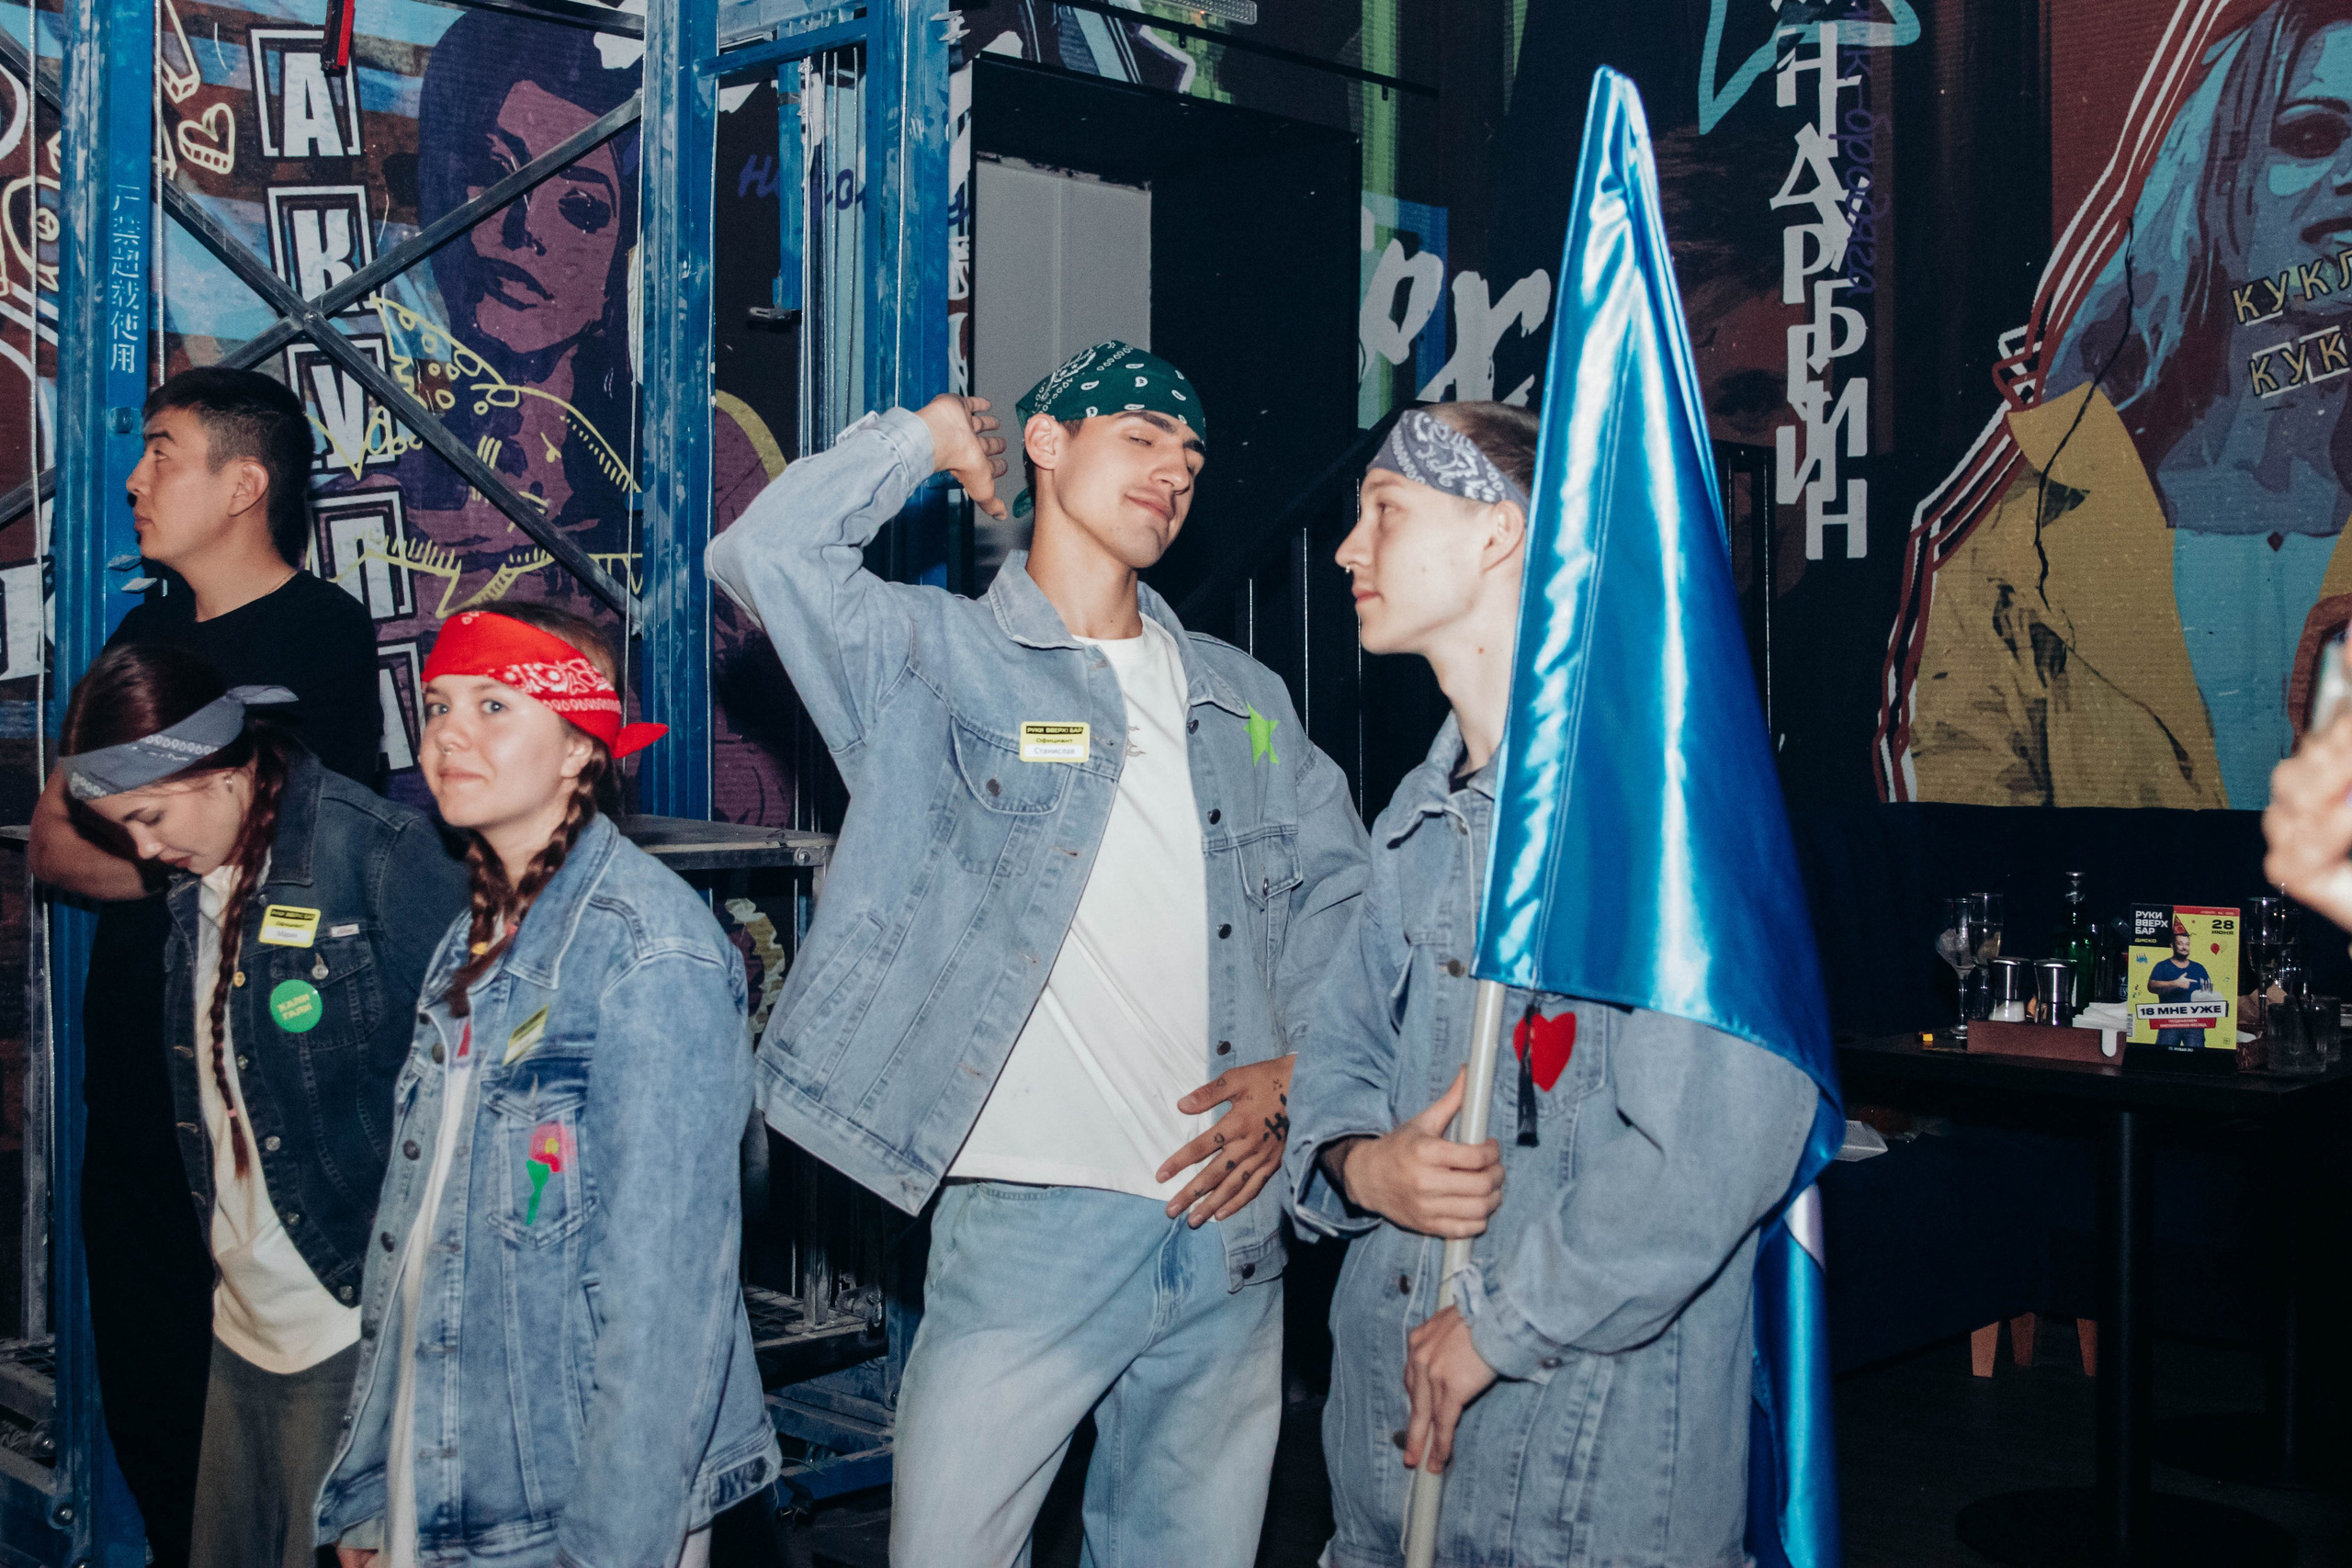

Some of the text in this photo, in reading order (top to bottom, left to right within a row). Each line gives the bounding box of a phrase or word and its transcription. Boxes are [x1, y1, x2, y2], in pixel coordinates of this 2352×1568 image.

[1034, 747, 1076, 755] Станислав
[2135, 910, 2163, 919] РУКИ
[2135, 919, 2168, 928] ВВЕРХ
[2211, 919, 2234, 930] 28
[2134, 927, 2155, 935] БАР
[2140, 1005, 2222, 1016] 18 МНЕ УЖЕ
